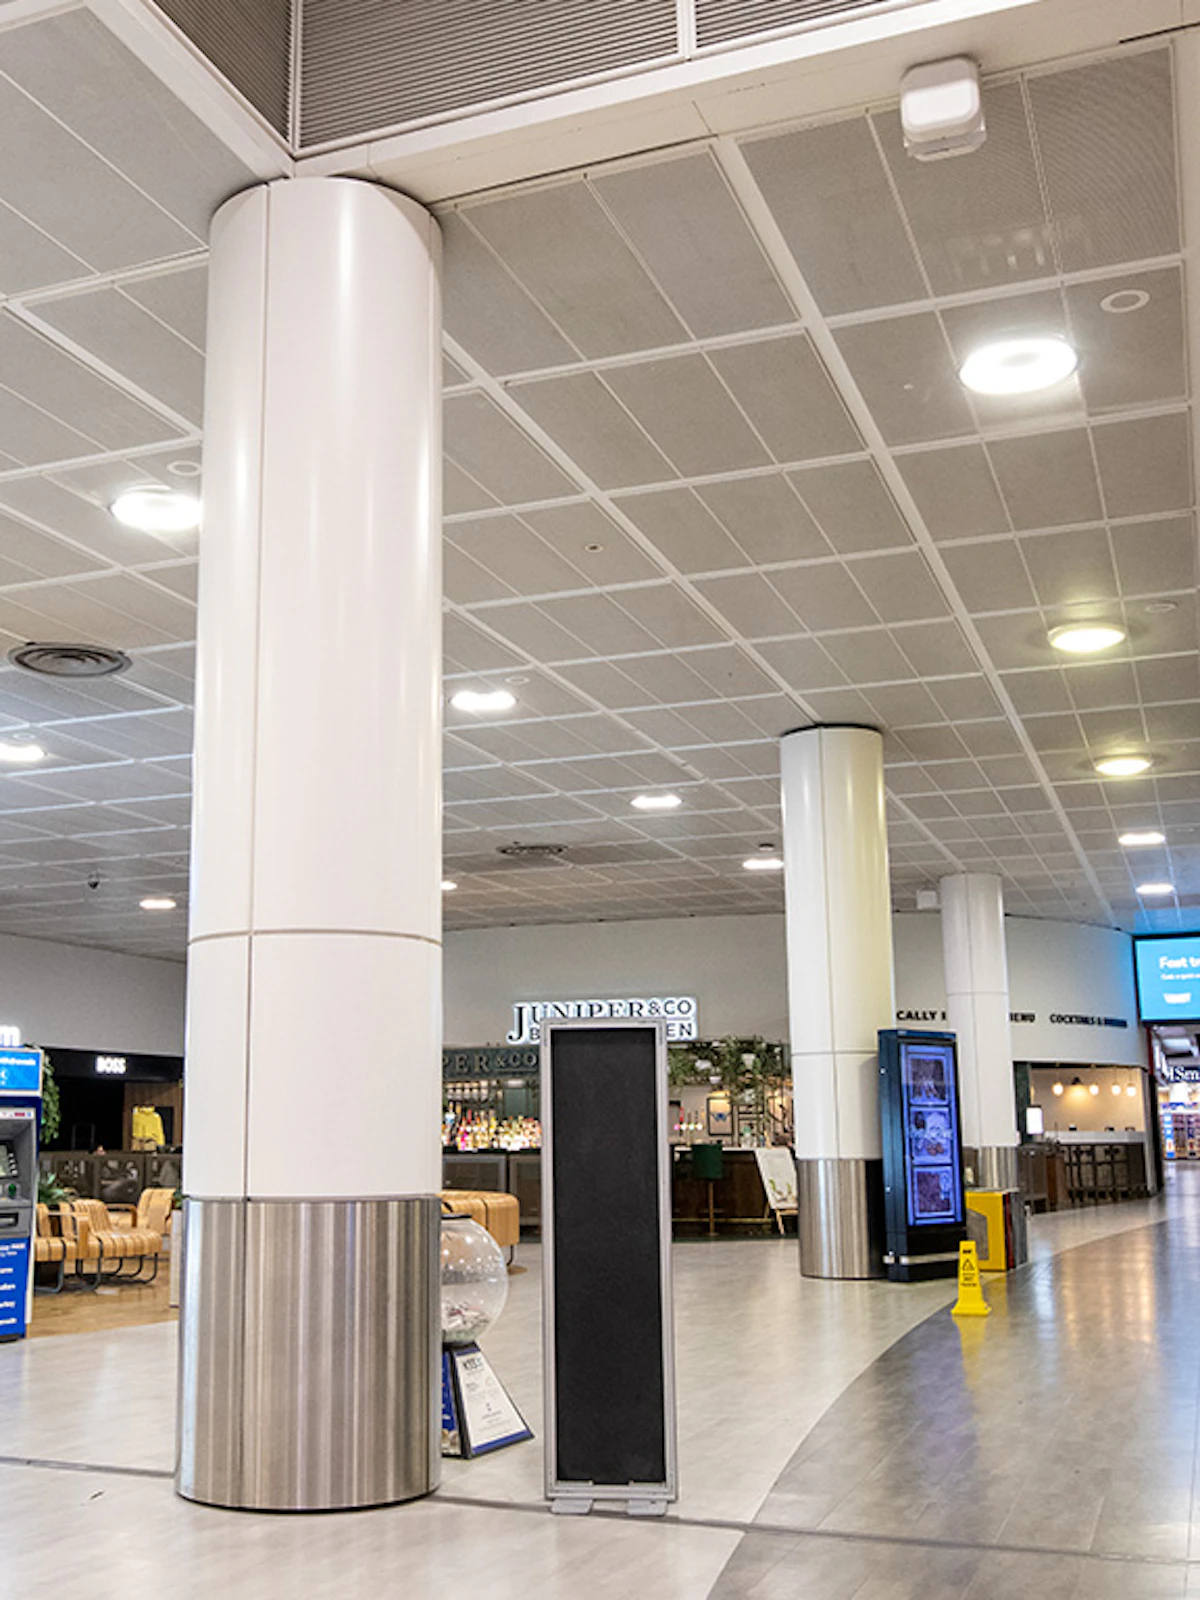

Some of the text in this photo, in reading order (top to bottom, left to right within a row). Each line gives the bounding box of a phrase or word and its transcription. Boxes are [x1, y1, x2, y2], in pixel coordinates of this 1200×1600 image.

[507, 999, 693, 1041] JUNIPER&CO
[896, 1010, 937, 1020] CALLY
[96, 1056, 126, 1074] BOSS
